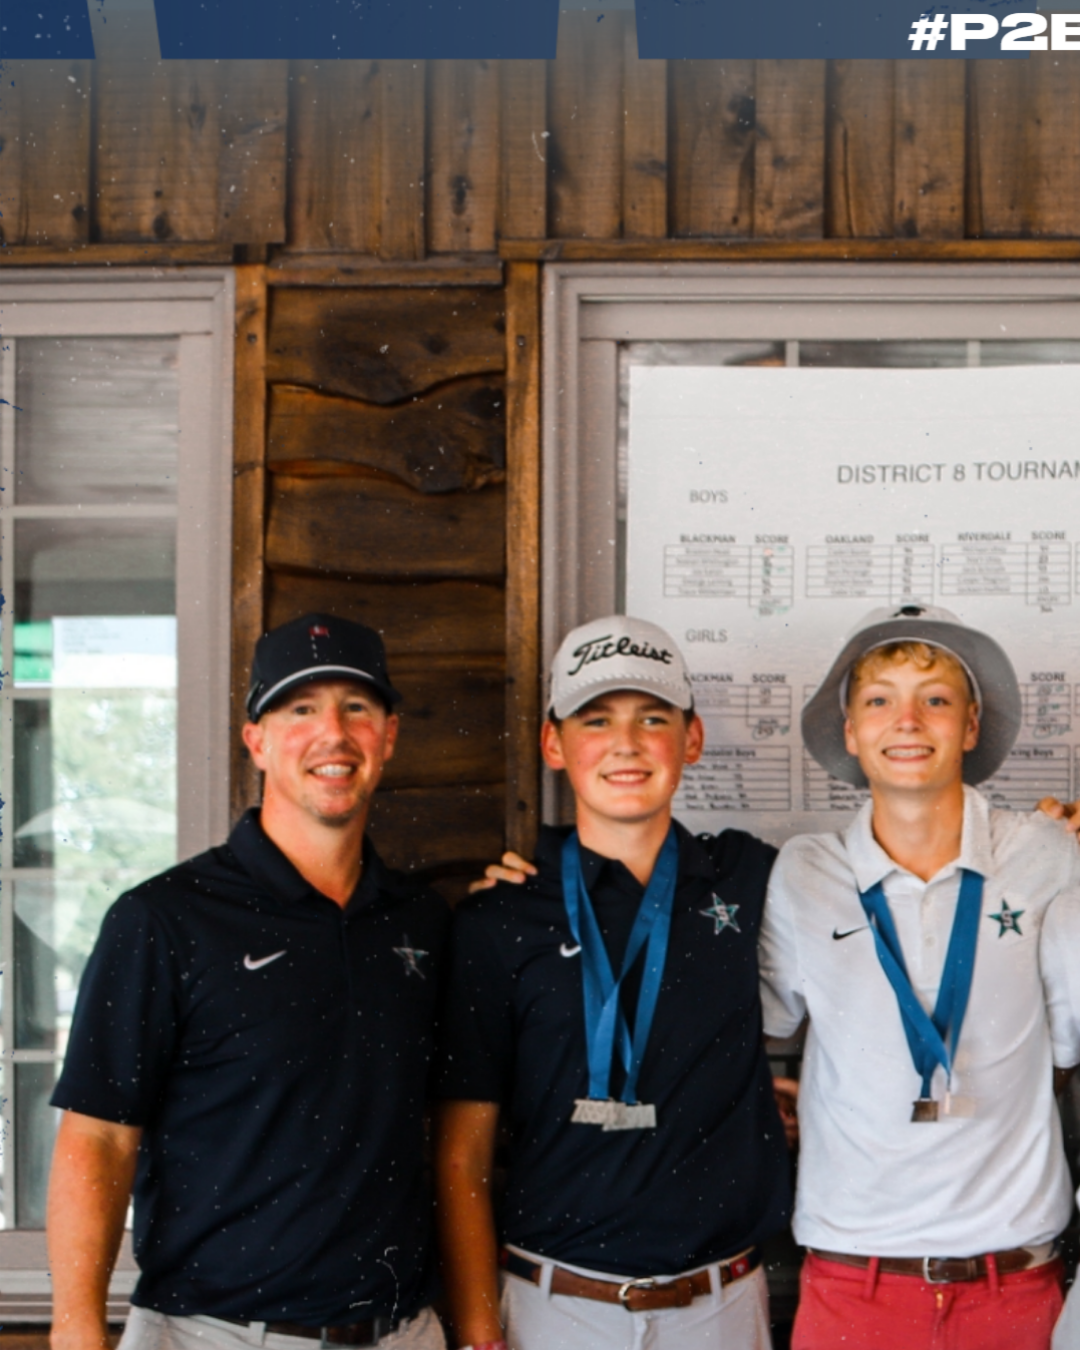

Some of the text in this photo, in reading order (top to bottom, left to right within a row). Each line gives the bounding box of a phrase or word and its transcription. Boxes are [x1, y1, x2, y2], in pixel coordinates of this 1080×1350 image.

[837, 463, 947, 484] DISTRICT
[952, 463, 966, 482] 8
[689, 489, 729, 504] BOYS
[680, 533, 736, 544] BLACKMAN
[755, 533, 789, 544] SCORE
[825, 534, 874, 544] OAKLAND
[896, 533, 930, 543] SCORE
[957, 532, 1012, 542] RIVERDALE
[1031, 531, 1066, 541] SCORE
[685, 628, 728, 644] GIRLS
[567, 634, 674, 676] Titleist
[689, 672, 733, 683] ACKMAN
[752, 673, 787, 684] SCORE
[1030, 672, 1066, 682] SCORE
